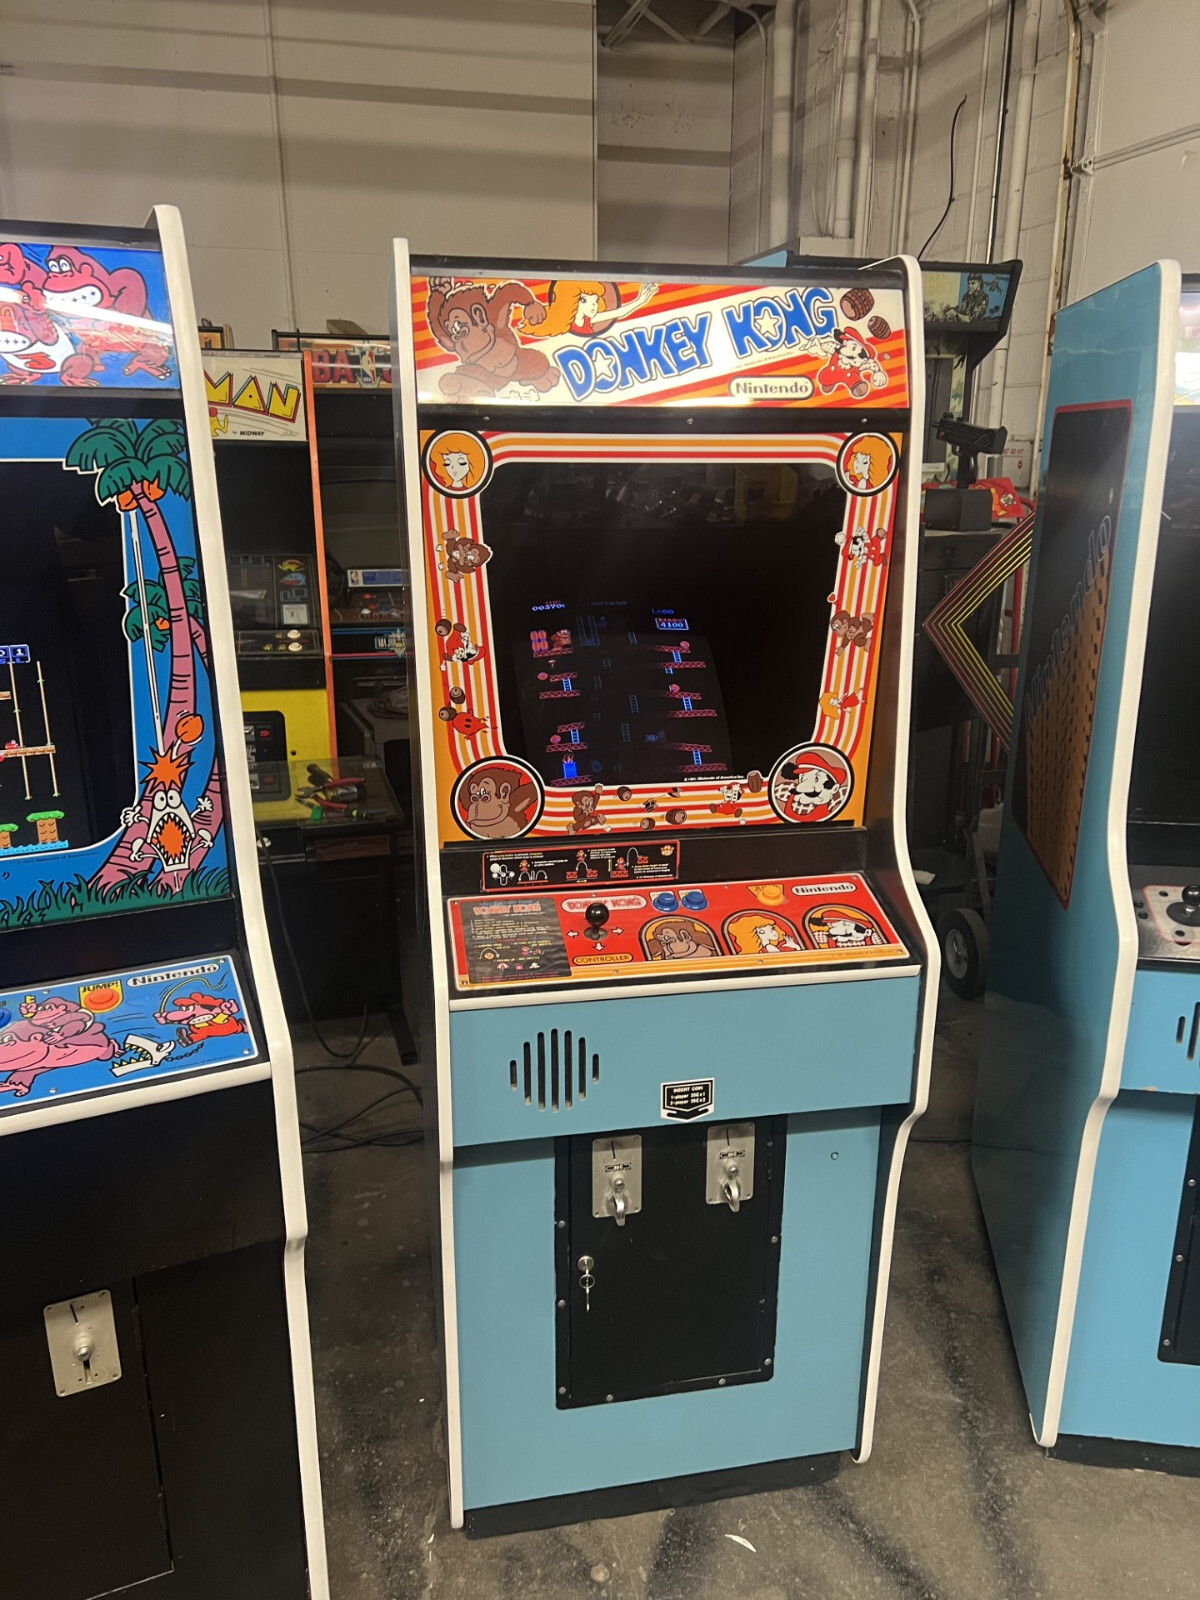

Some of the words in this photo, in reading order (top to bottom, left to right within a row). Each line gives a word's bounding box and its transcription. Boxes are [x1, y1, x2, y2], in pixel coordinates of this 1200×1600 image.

[555, 312, 712, 400] DONKEY
[722, 287, 838, 359] KONG
[735, 381, 809, 396] Nintendo
[204, 370, 301, 423] MAN
[795, 882, 854, 895] Nintendo
[611, 898, 641, 907] KONG
[576, 954, 631, 964] CONTROLLER
[132, 964, 218, 985] Nintendo
[82, 981, 119, 993] JUMP!
